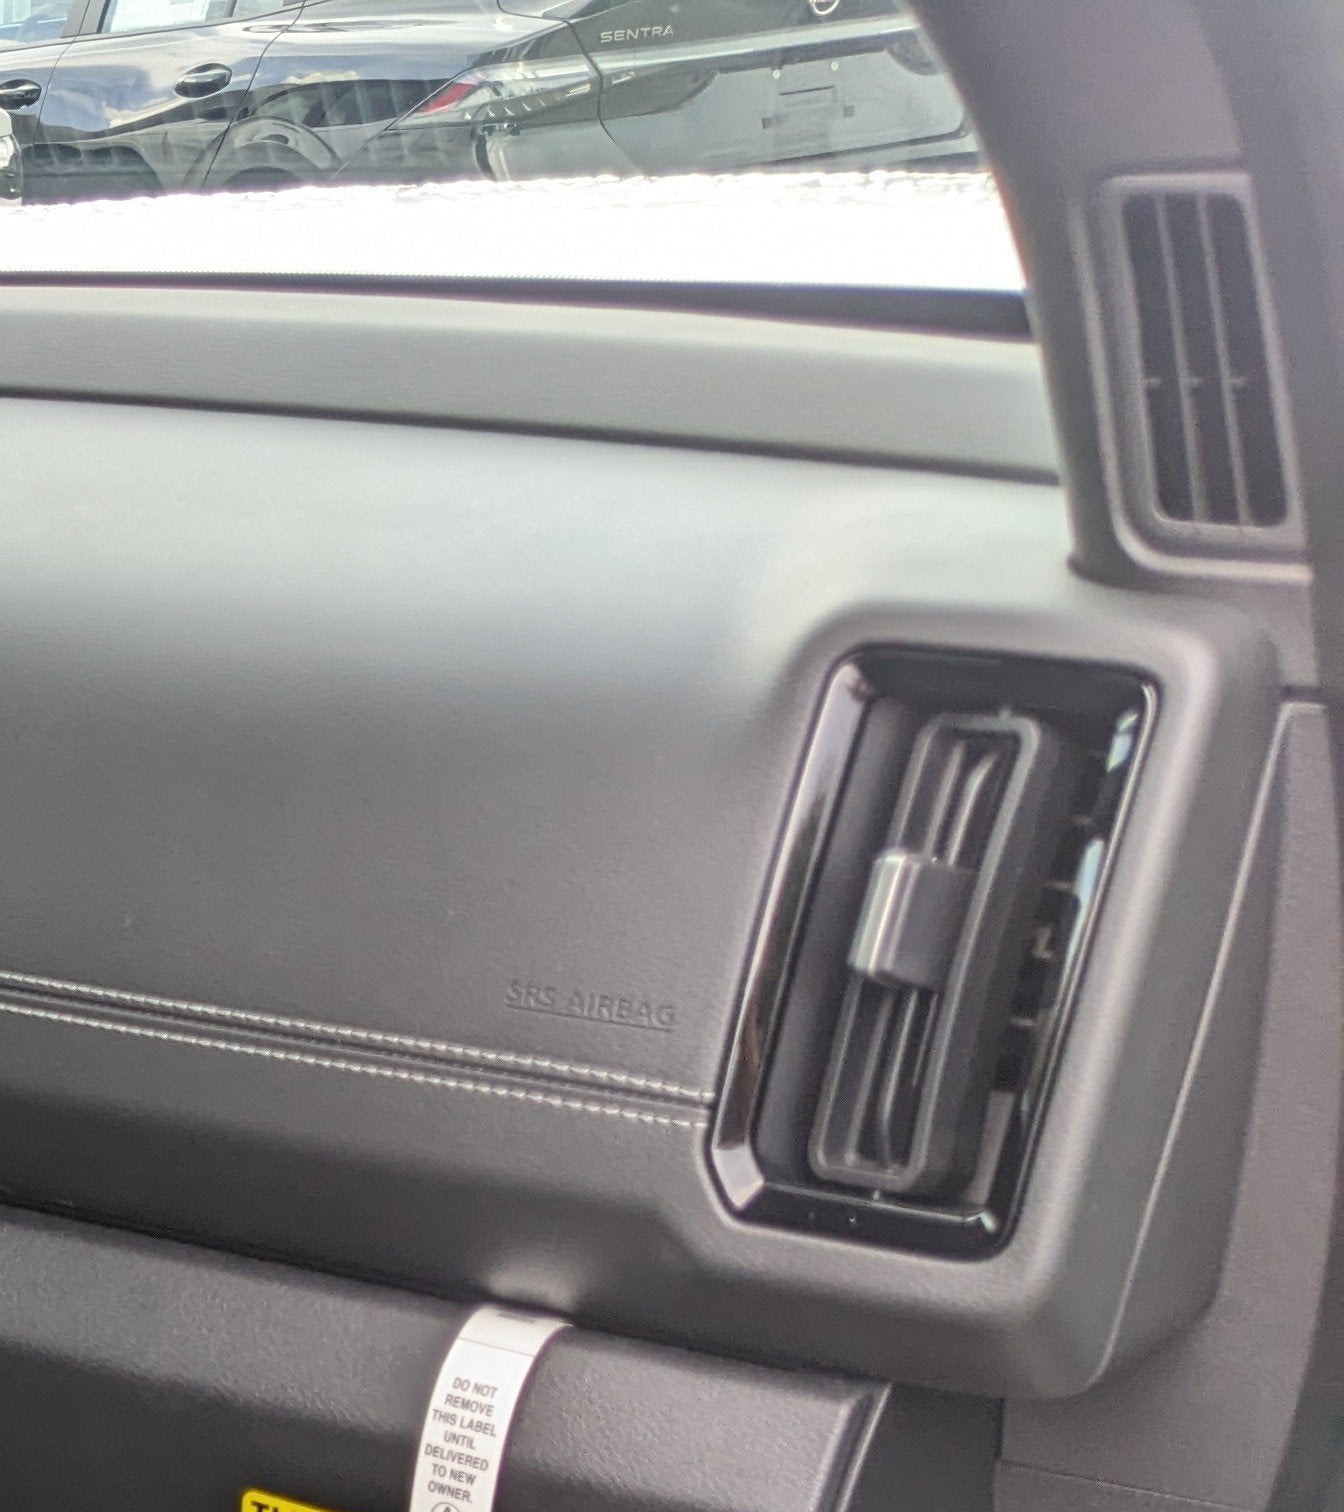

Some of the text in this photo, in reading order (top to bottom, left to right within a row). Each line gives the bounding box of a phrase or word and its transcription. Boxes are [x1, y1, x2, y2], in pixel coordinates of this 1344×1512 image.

[599, 25, 674, 44] SENTRA
[452, 1376, 499, 1400] DO NOT
[444, 1393, 495, 1417] REMOVE
[432, 1408, 497, 1437] THIS LABEL
[443, 1430, 476, 1450] UNTIL
[424, 1444, 489, 1472] DELIVERED
[432, 1463, 477, 1486] TO NEW
[428, 1480, 472, 1503] OWNER.
